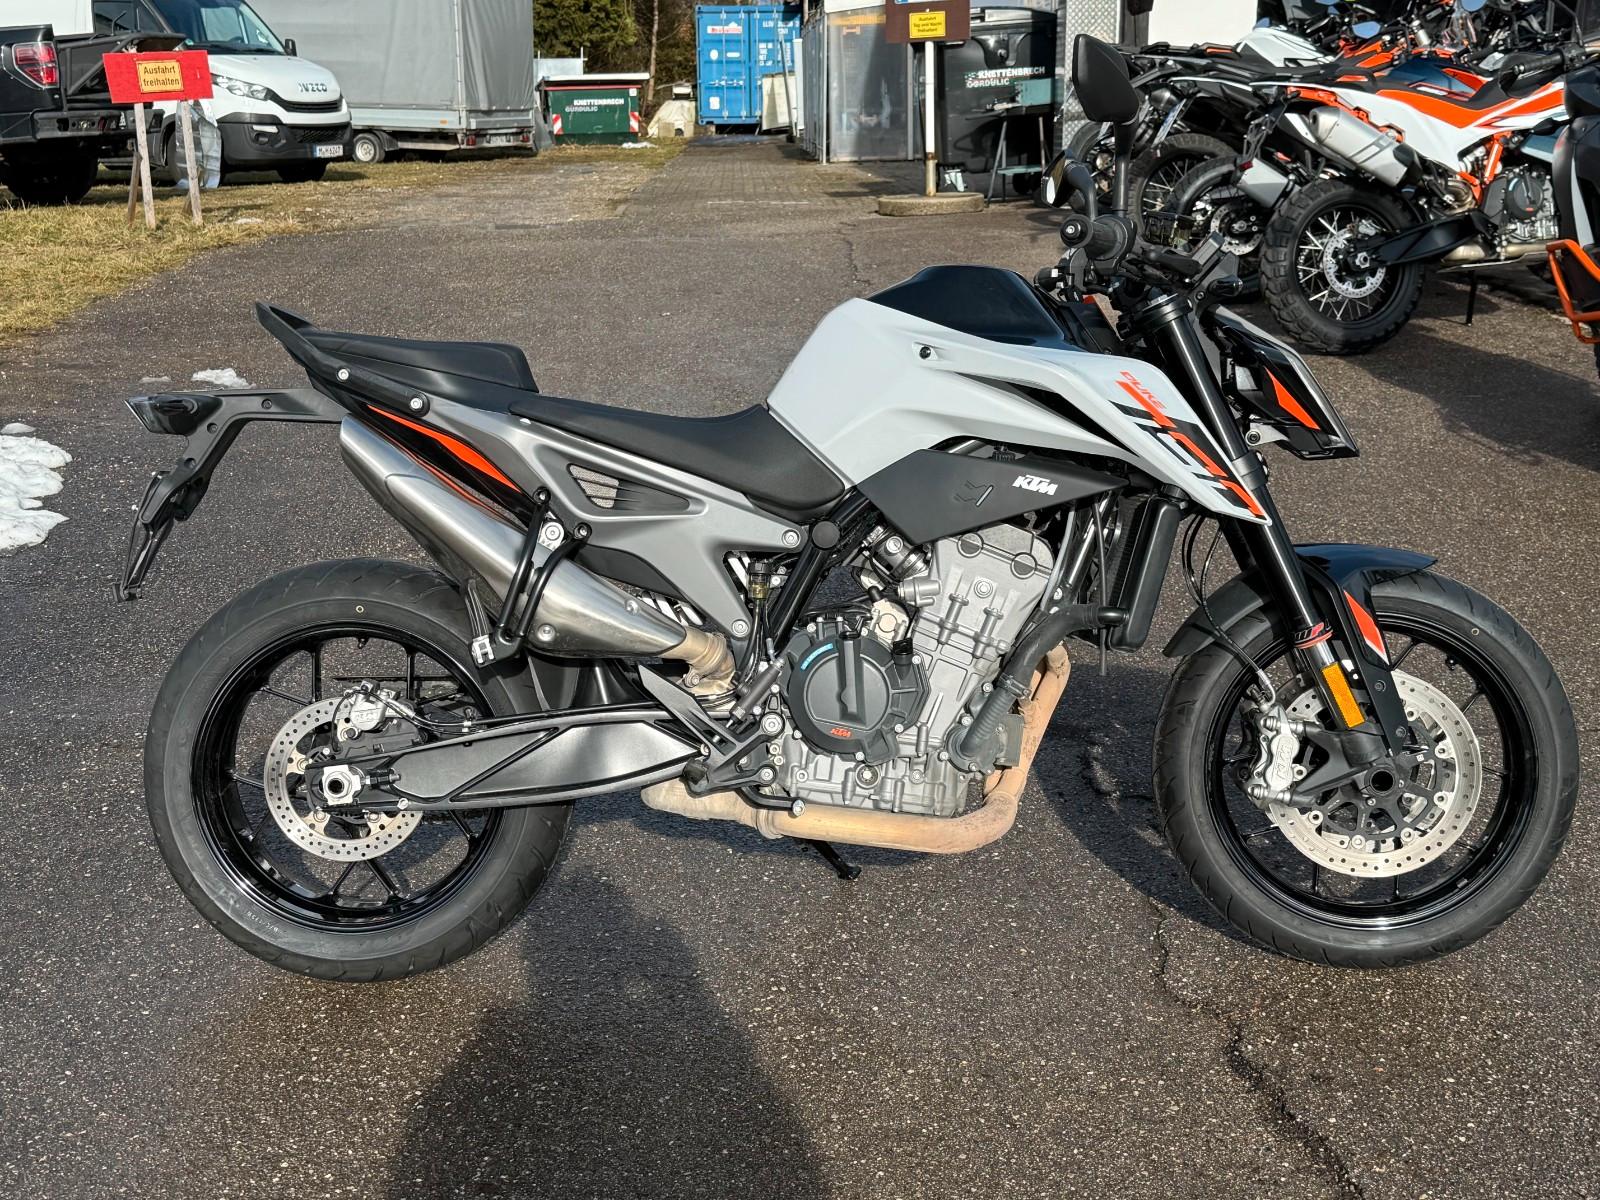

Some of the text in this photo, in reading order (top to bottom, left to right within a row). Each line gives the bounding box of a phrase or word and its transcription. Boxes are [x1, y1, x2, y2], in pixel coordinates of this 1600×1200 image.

[143, 65, 176, 75] Ausfahrt
[143, 77, 180, 87] freihalten
[298, 82, 328, 93] IVECO
[1119, 371, 1168, 410] DUKE
[1012, 474, 1058, 496] KTM
